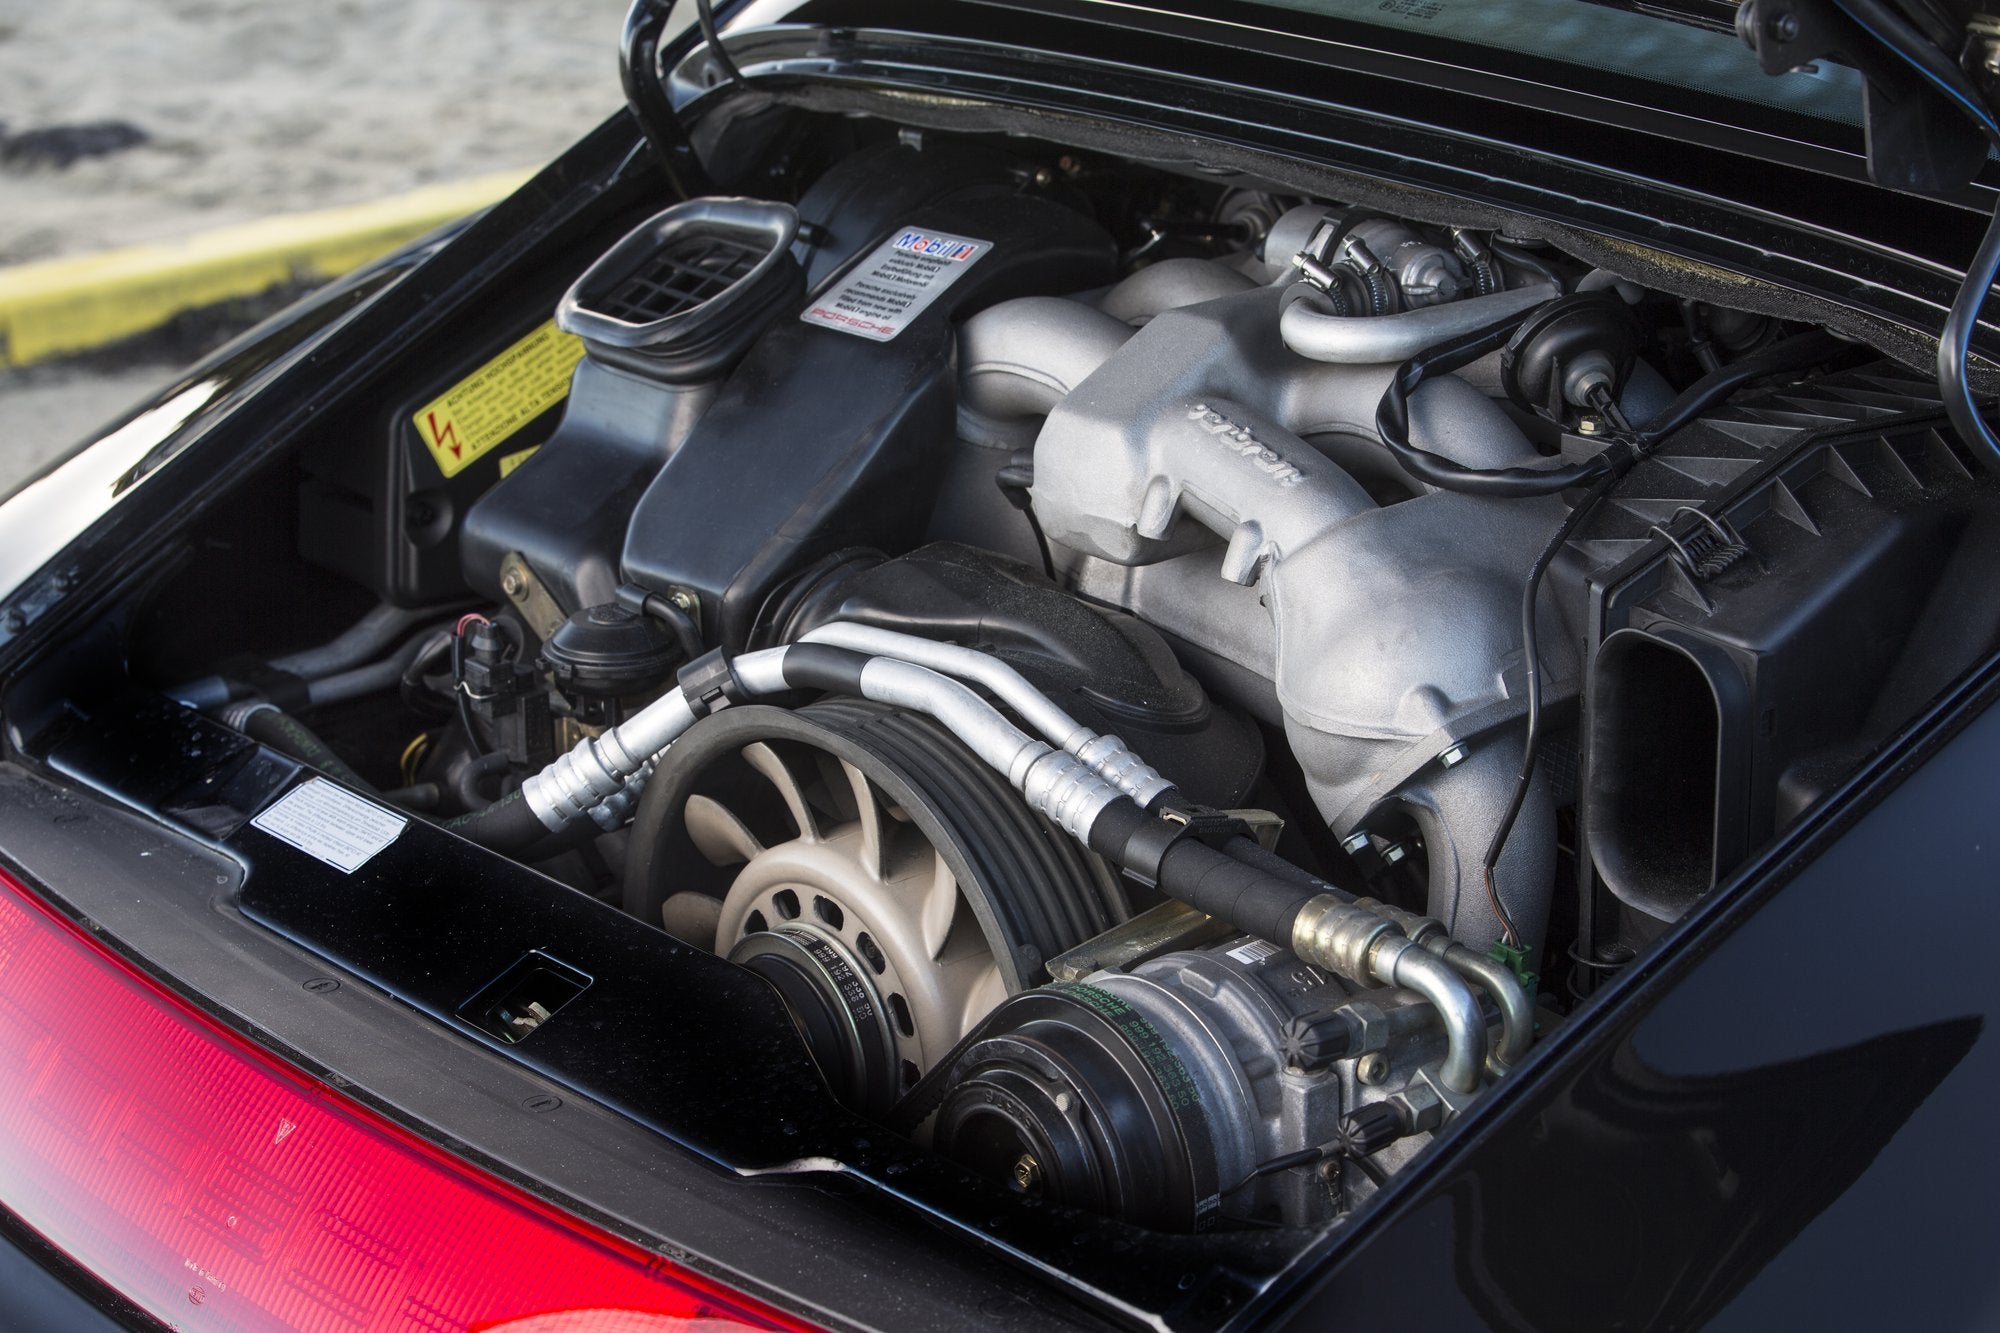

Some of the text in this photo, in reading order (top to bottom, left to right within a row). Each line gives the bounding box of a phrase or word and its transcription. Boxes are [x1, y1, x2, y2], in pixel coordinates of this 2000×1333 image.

[896, 232, 955, 256] Mobil
[894, 250, 920, 259] Porsche
[854, 281, 882, 291] Porsche
[843, 288, 887, 301] recommends
[856, 299, 873, 307] from
[887, 306, 903, 314] with
[857, 309, 881, 318] engine
[810, 307, 896, 335] PORSCHE
